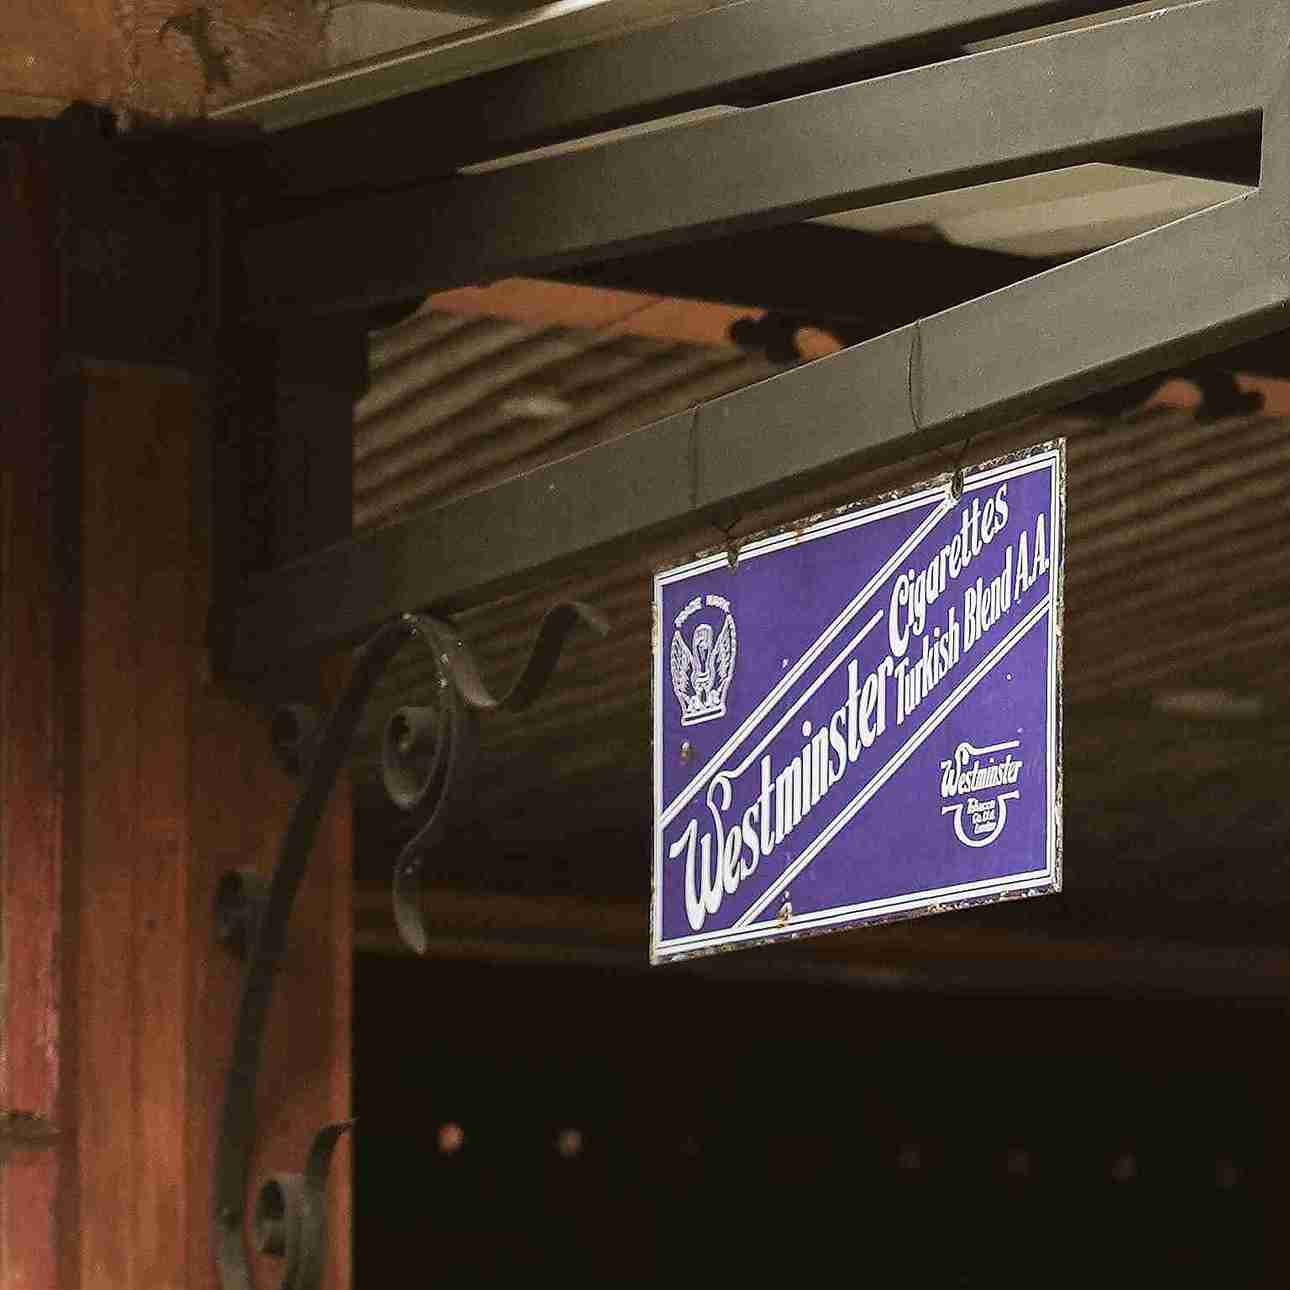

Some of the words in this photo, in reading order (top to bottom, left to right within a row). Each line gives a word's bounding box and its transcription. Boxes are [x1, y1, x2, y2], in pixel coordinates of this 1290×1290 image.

[889, 482, 1008, 657] Cigarettes
[894, 607, 960, 726] Turkish
[963, 545, 1012, 653] Blend
[1013, 513, 1050, 601] A.A.
[669, 655, 894, 930] Westminster
[940, 742, 1022, 798] Westminster
